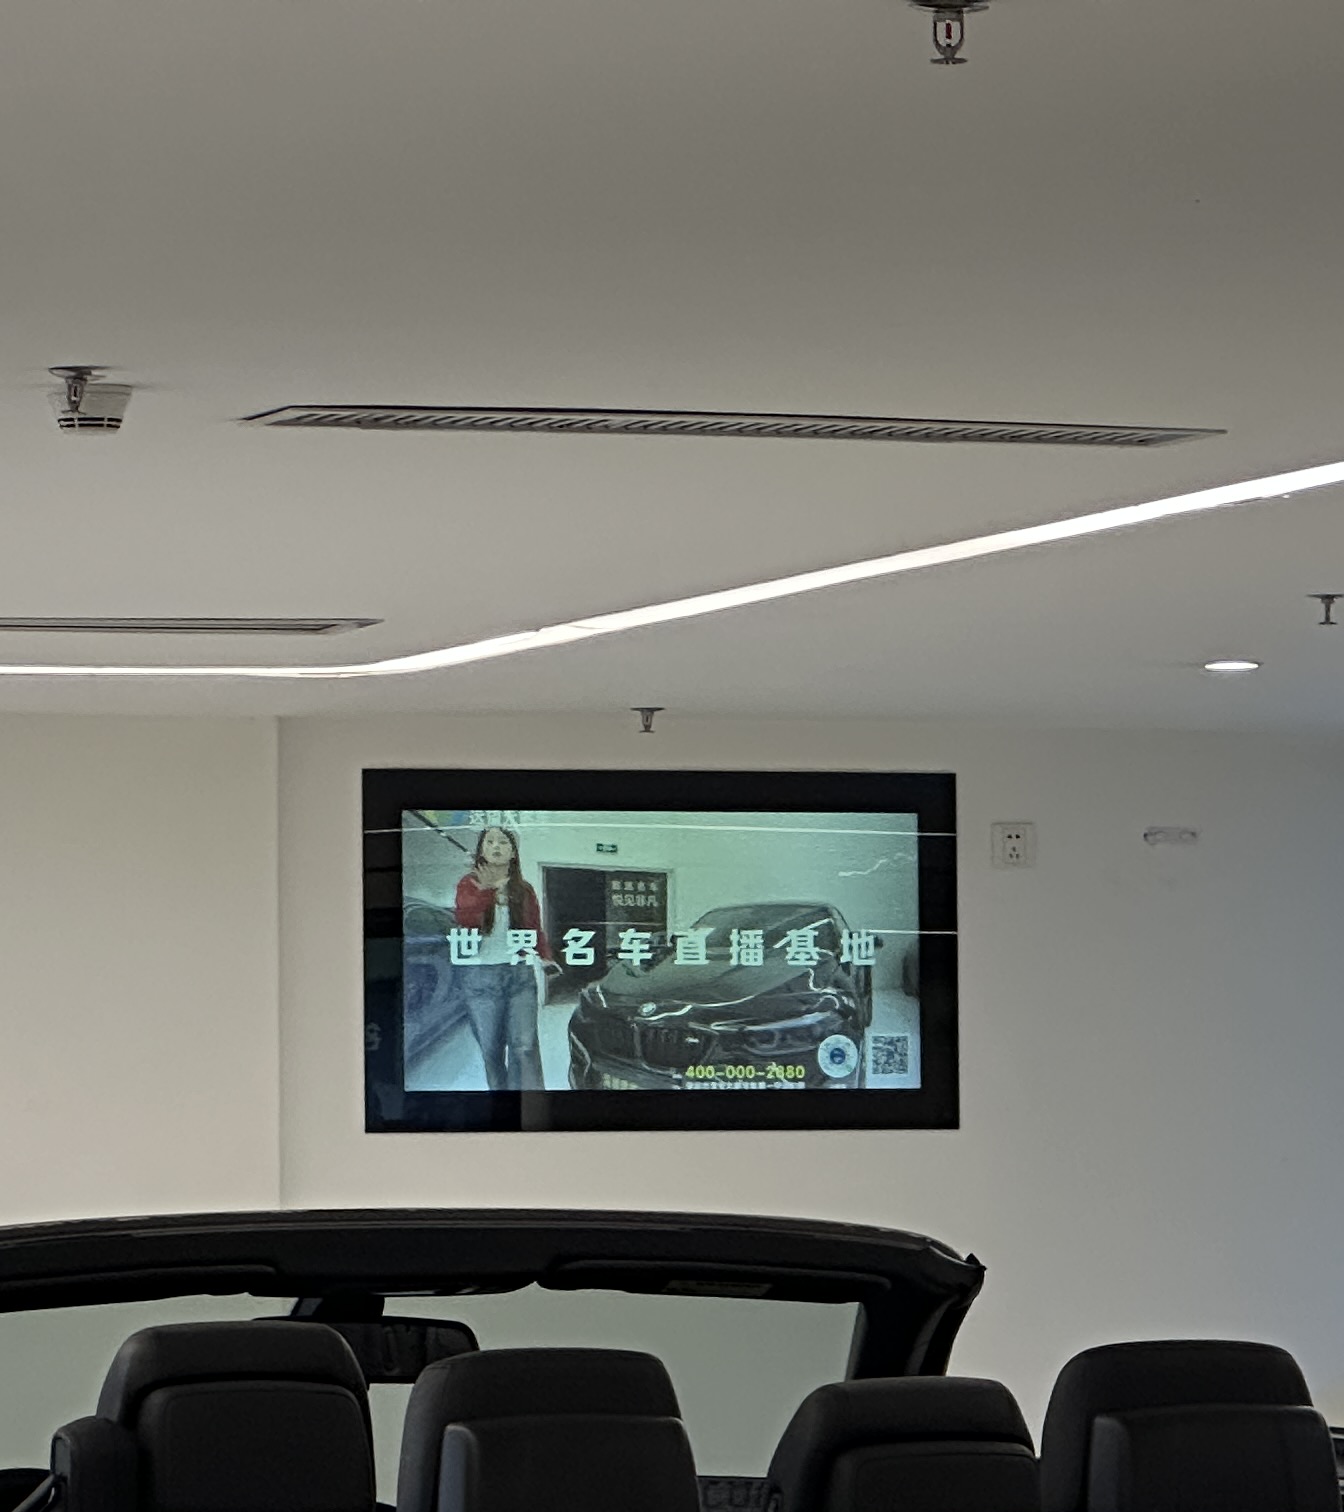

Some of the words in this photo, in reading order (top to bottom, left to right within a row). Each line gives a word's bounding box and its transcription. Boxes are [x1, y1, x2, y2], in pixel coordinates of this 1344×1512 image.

[446, 928, 877, 966] 世界名车直播基地
